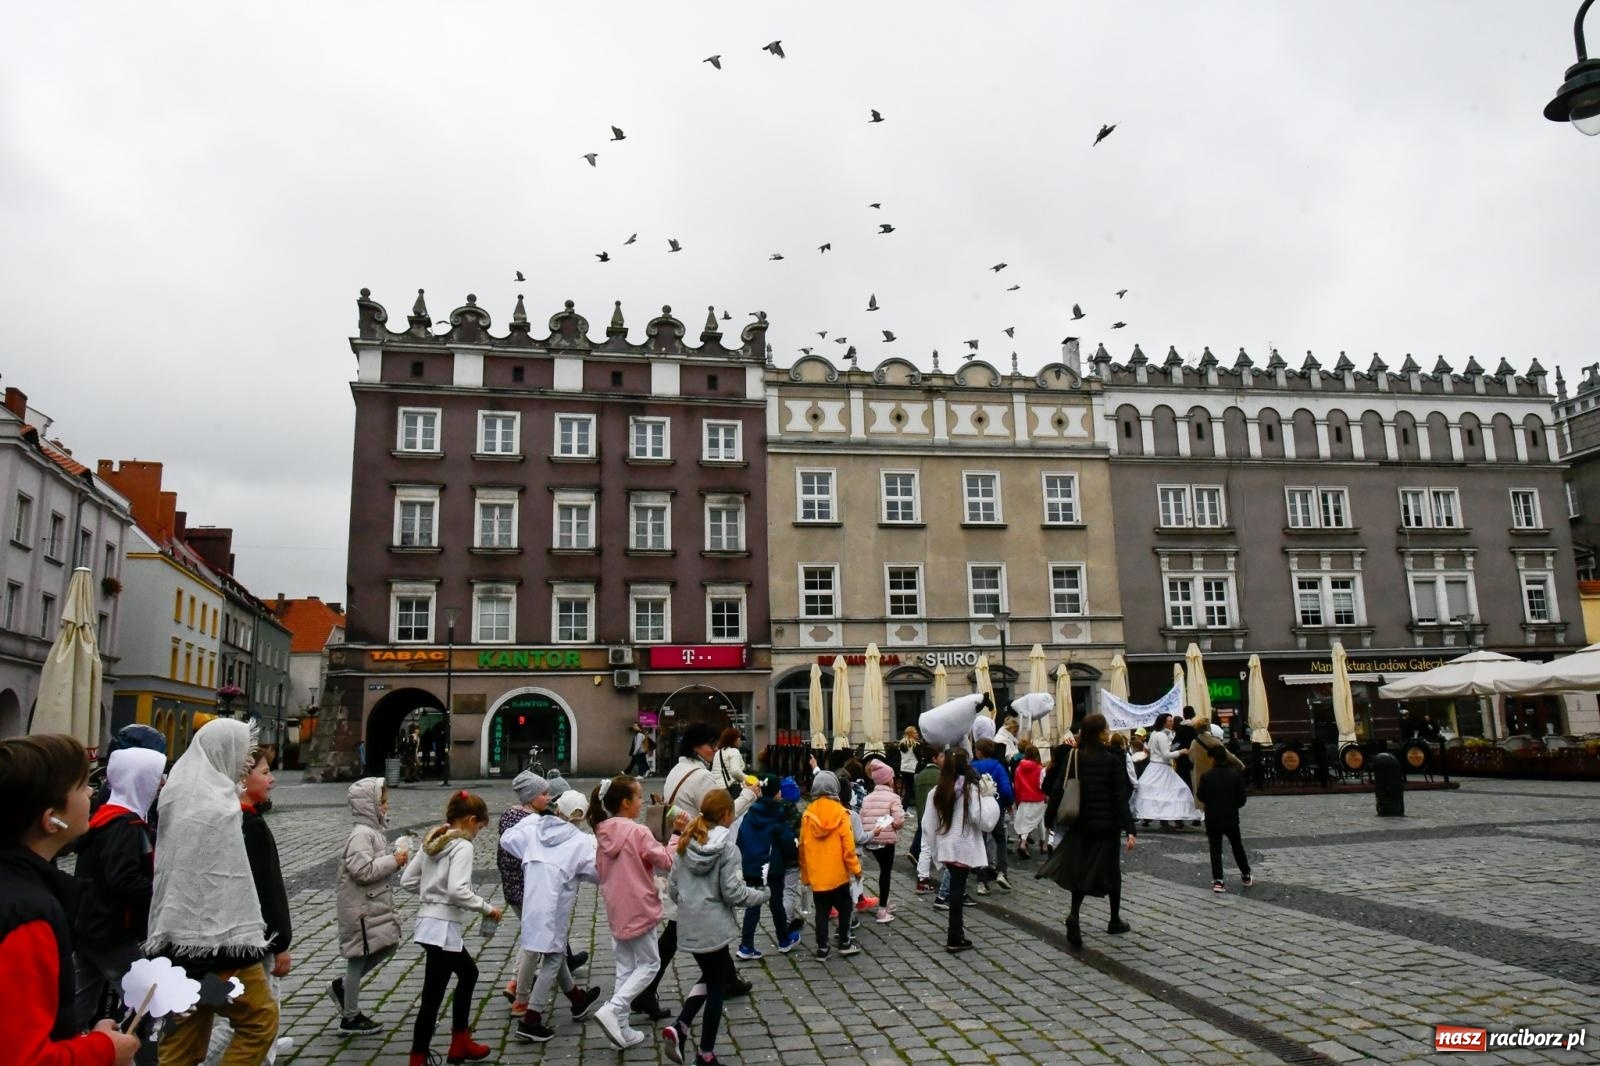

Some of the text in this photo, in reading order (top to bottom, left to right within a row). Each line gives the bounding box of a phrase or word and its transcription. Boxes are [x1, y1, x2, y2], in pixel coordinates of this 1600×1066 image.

[371, 651, 444, 660] TABAC
[479, 650, 580, 668] KANTOR
[925, 652, 977, 666] SHIRO
[1311, 660, 1371, 672] Manktura
[1374, 659, 1407, 671] Lodów
